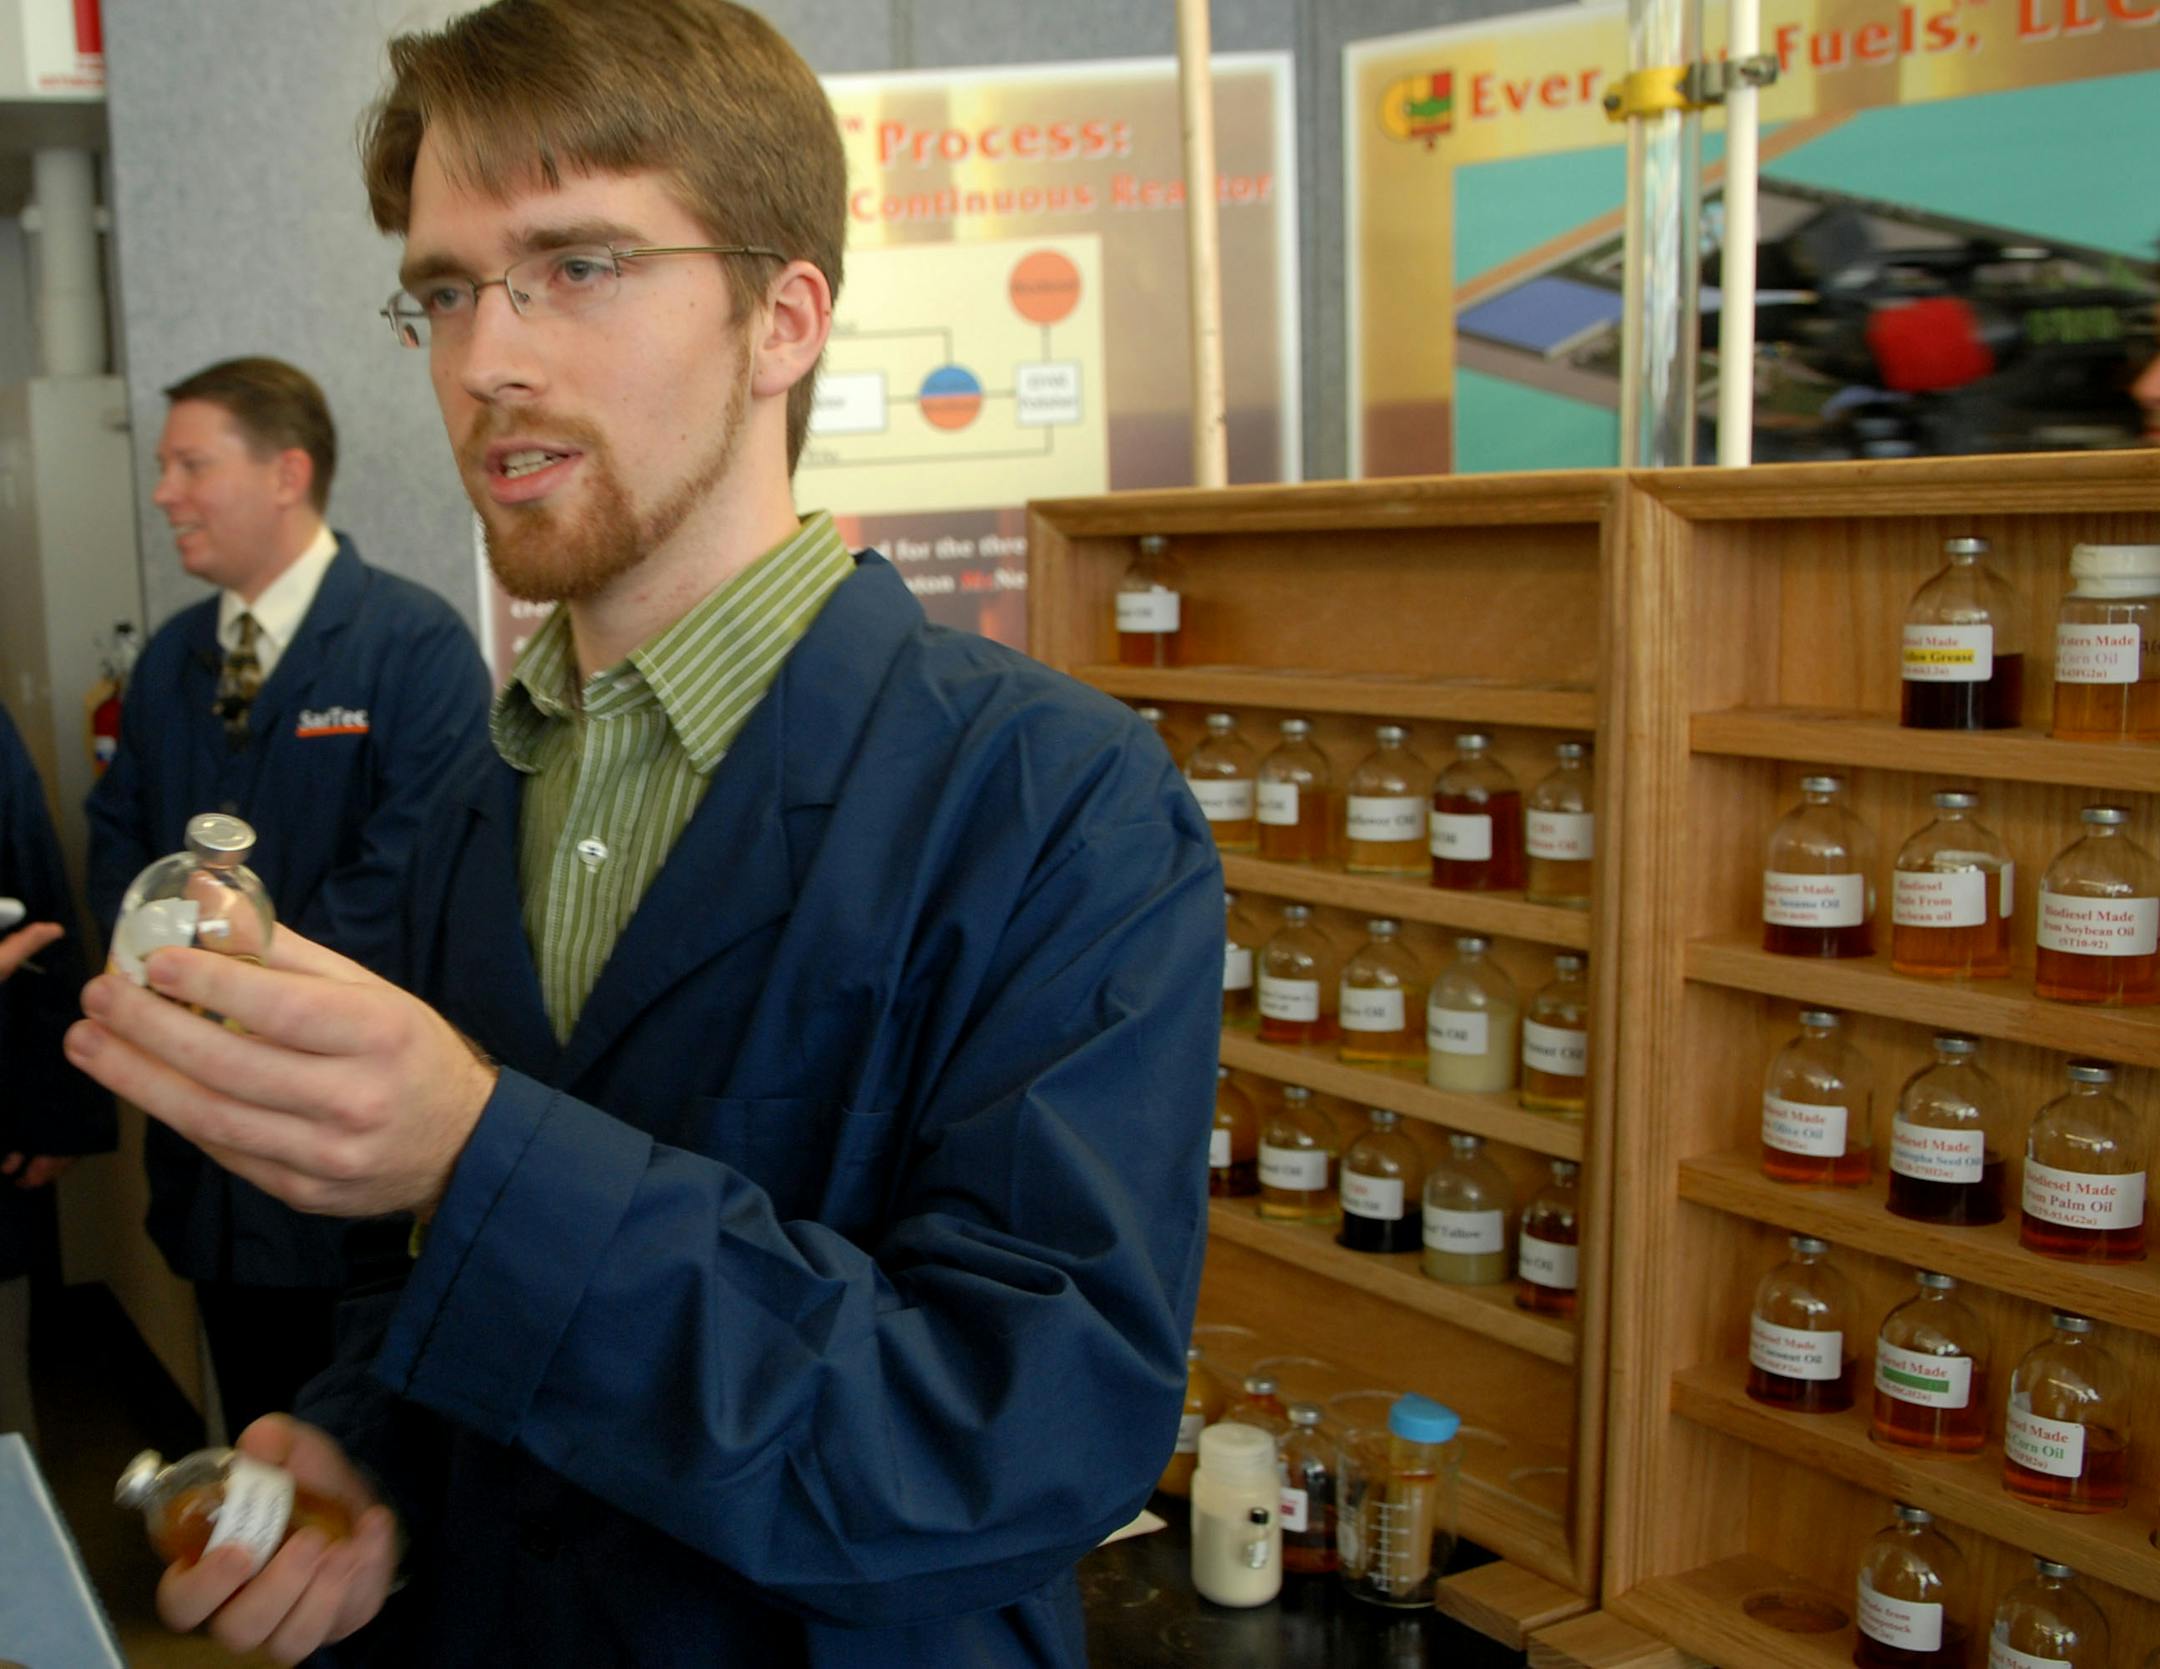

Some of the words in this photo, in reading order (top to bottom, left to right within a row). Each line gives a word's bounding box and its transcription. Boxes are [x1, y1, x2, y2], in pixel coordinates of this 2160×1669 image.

[877, 116, 1130, 168] Process:
[850, 182, 1093, 222] Continuous
[1110, 170, 1273, 207] Reator
[2095, 634, 2134, 648] Made
[1930, 650, 1975, 664] Grease
[2095, 651, 2119, 666] Oil
[1918, 896, 1953, 907] From
[2044, 903, 2093, 921] Biodiesel
[2096, 910, 2136, 923] Made
[2063, 923, 2114, 938] Soybean
[2116, 926, 2136, 938] Oil
[1791, 1110, 1826, 1124] Made
[1932, 1138, 1972, 1153] Made
[2075, 1182, 2118, 1197] Made
[2049, 1194, 2086, 1212] Palm
[2090, 1199, 2113, 1214] Oil
[1910, 1360, 1949, 1379] Made
[2030, 1424, 2069, 1444] Made
[2042, 1444, 2066, 1460] Oil
